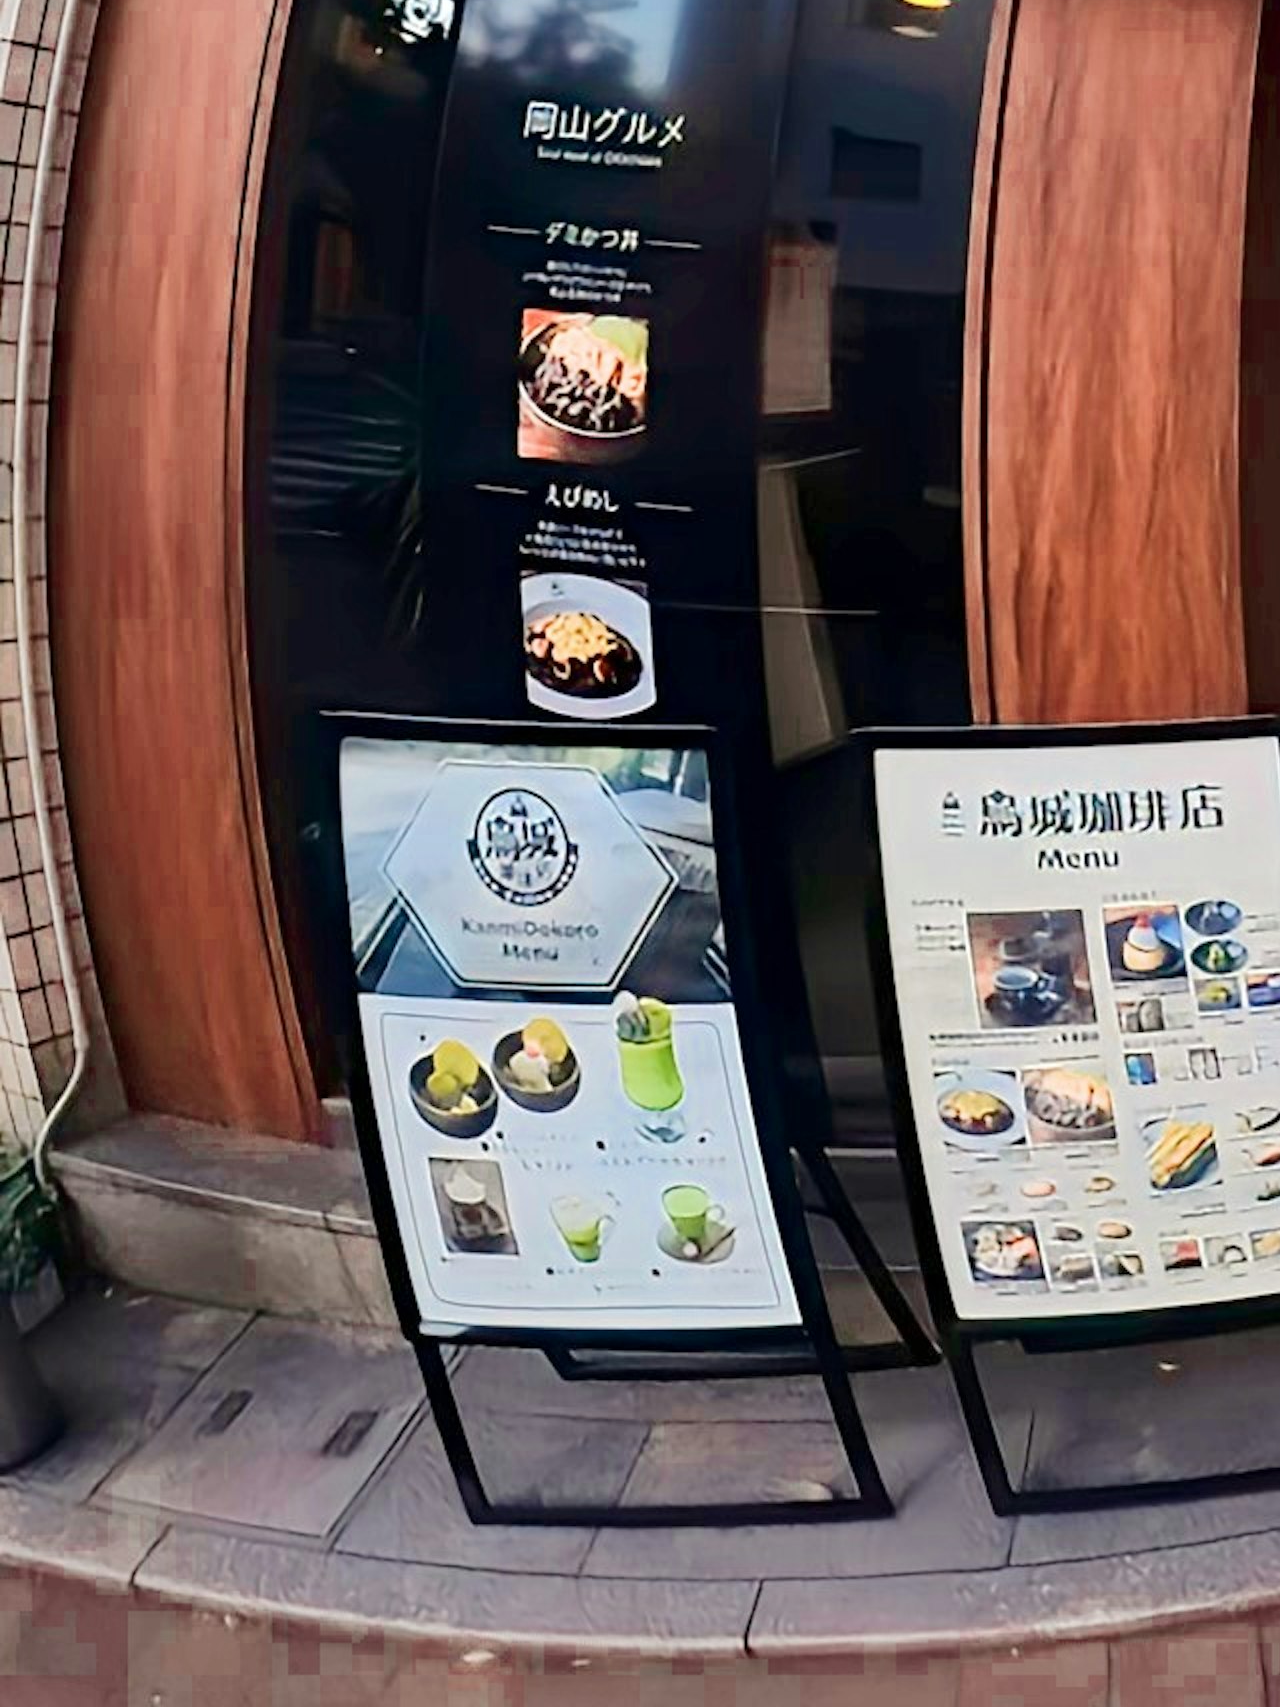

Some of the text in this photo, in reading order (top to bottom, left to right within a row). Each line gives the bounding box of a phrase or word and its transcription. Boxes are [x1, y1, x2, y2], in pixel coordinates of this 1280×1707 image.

[523, 100, 687, 148] 岡山グルメ
[1037, 846, 1121, 872] Menu
